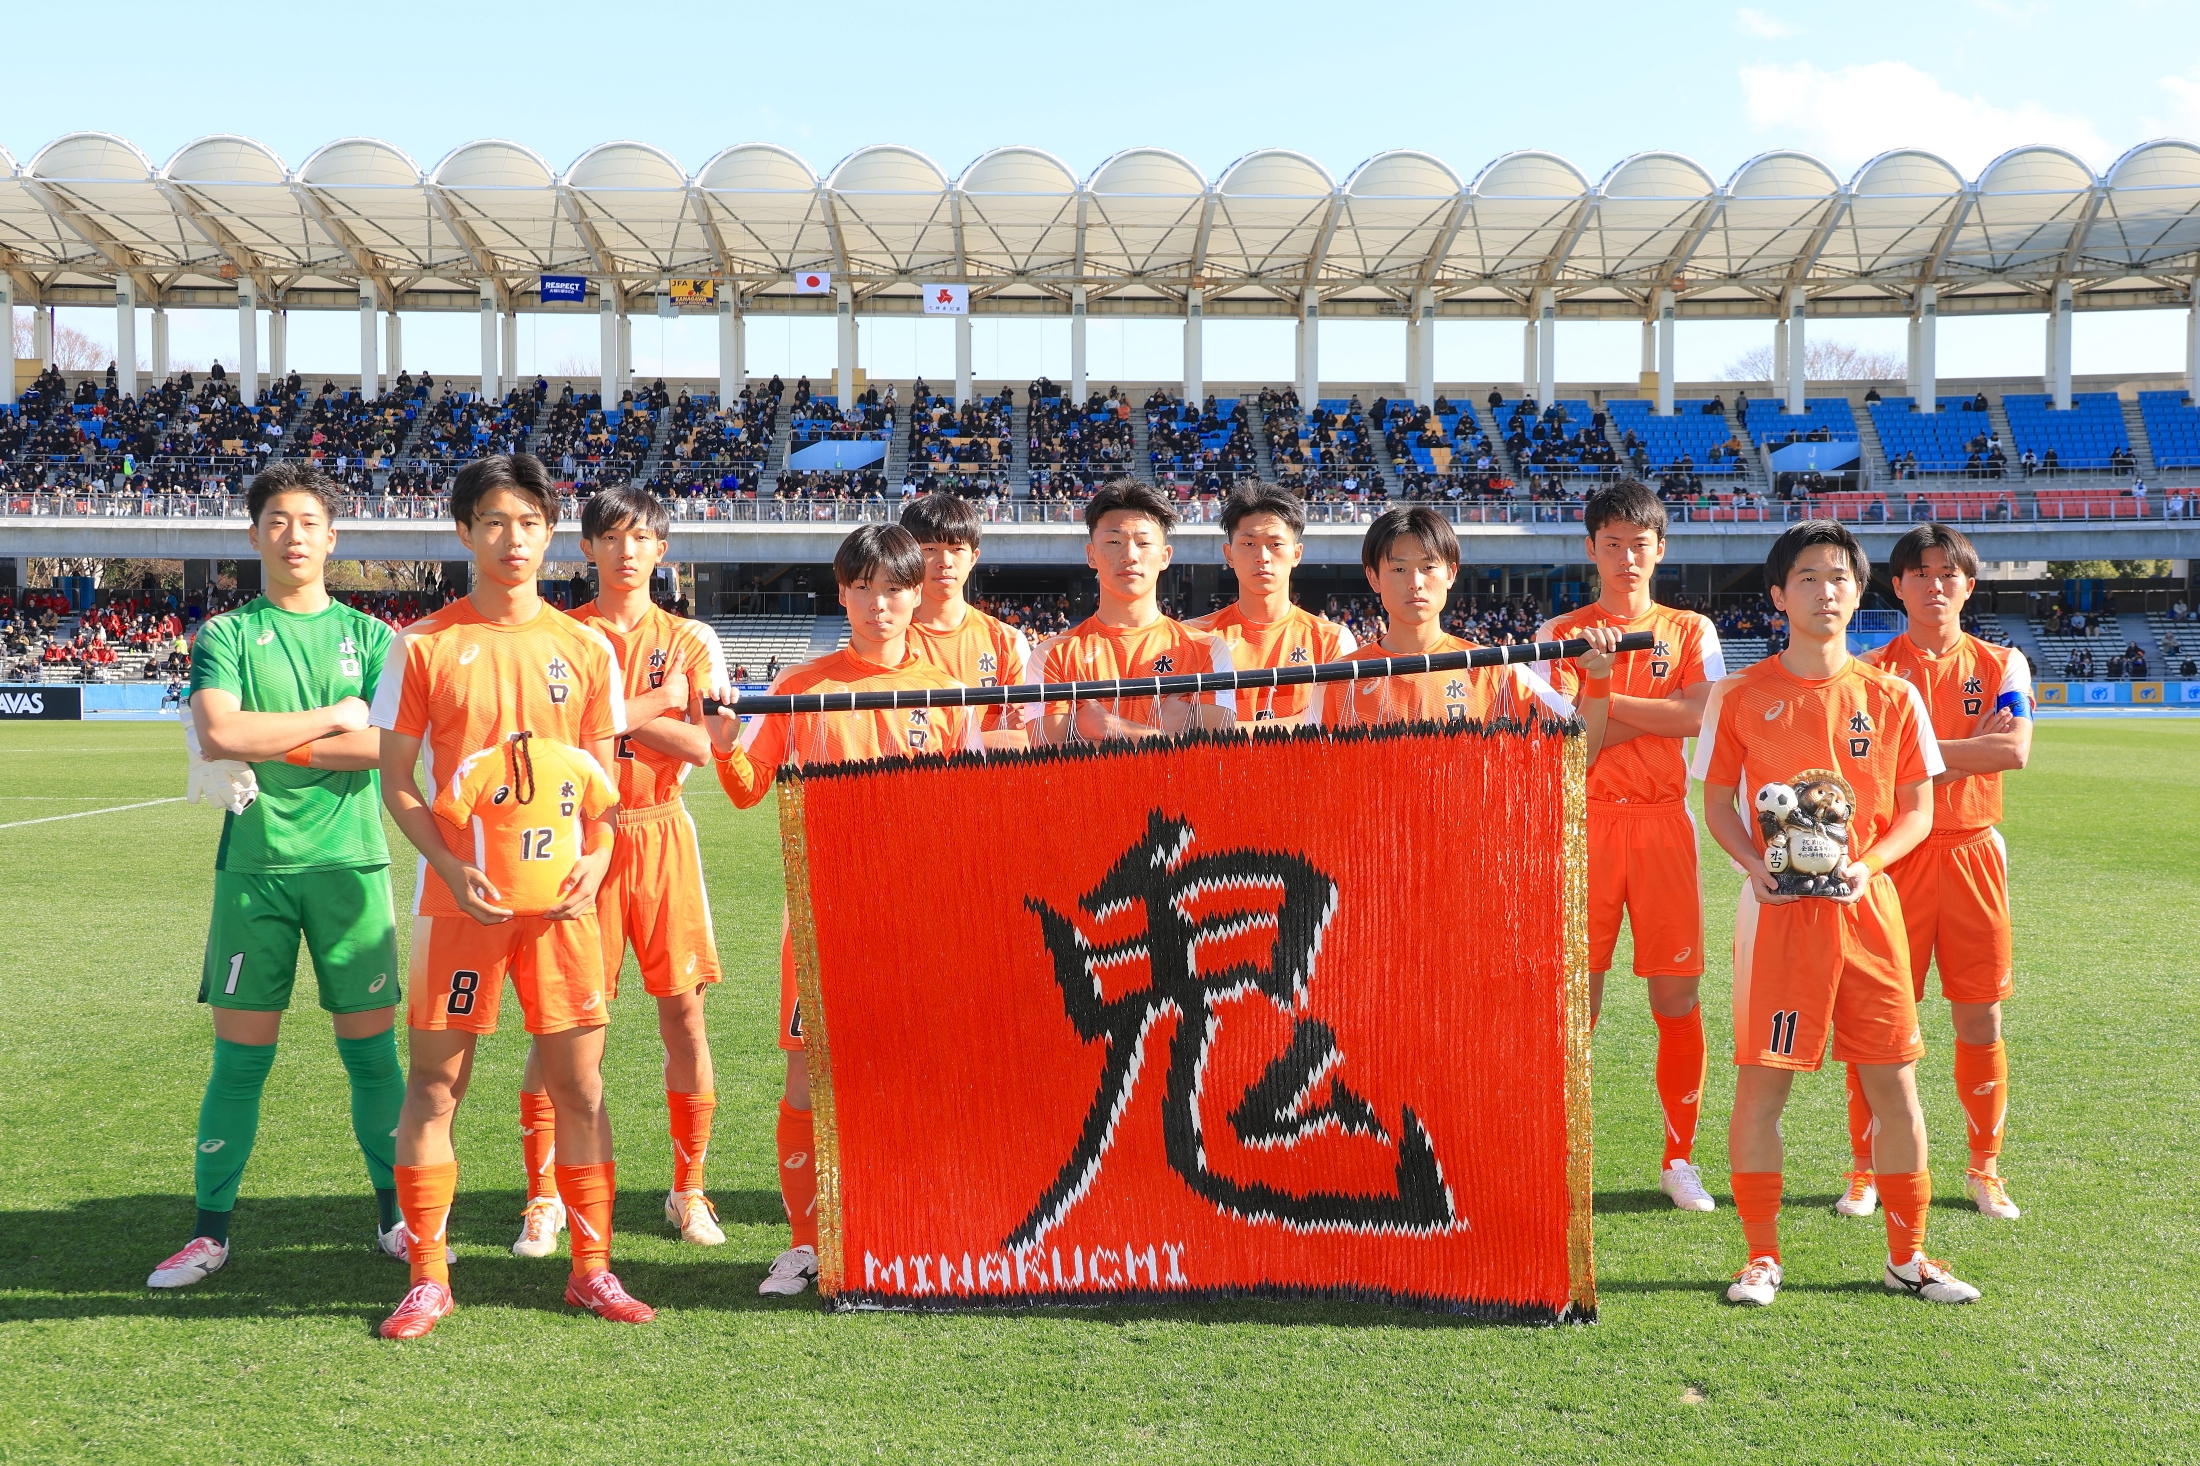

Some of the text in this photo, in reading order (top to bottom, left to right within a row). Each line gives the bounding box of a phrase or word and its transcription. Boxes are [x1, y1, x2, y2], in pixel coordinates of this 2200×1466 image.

[545, 281, 580, 291] RESPECT
[1808, 446, 1816, 458] J
[338, 636, 360, 677] 水口
[648, 648, 668, 689] 水口
[1650, 640, 1671, 678] 水口
[546, 657, 570, 704] 水口
[1445, 679, 1466, 721] 水口
[1962, 676, 1983, 716] 水口
[908, 708, 928, 749] 水口
[1849, 710, 1871, 758] 水口
[559, 779, 576, 817] 水口
[520, 828, 554, 861] 12
[1770, 850, 1782, 868] 水口
[223, 952, 246, 995] 1
[447, 970, 480, 1017] 8
[1002, 806, 1472, 1250] 鬼
[1770, 1009, 1799, 1056] 11
